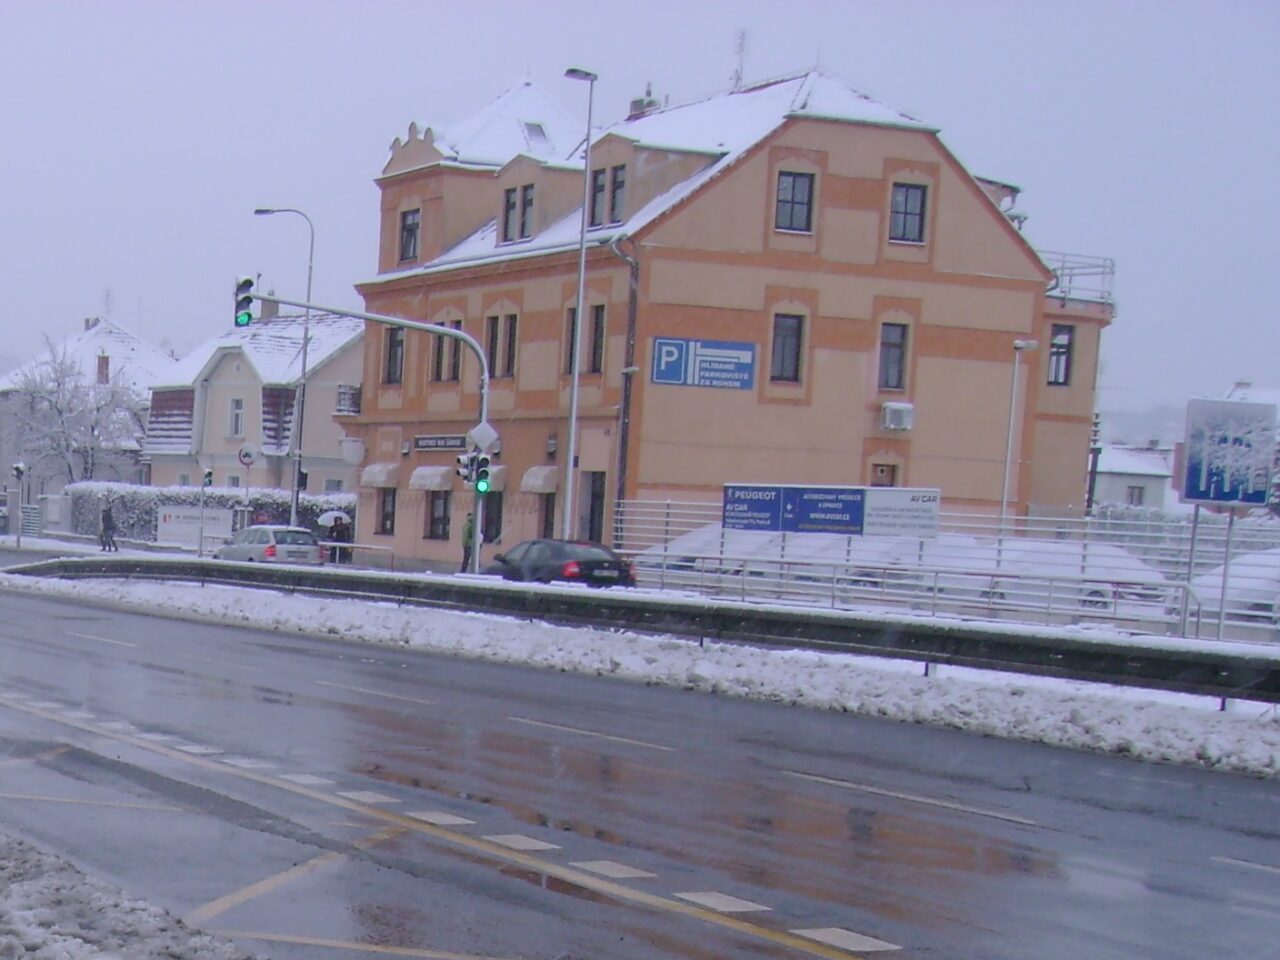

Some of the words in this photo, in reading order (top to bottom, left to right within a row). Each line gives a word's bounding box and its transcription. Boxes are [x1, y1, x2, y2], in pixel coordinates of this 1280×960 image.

[660, 345, 679, 370] P
[734, 490, 776, 500] PEUGEOT
[921, 495, 938, 503] CAR
